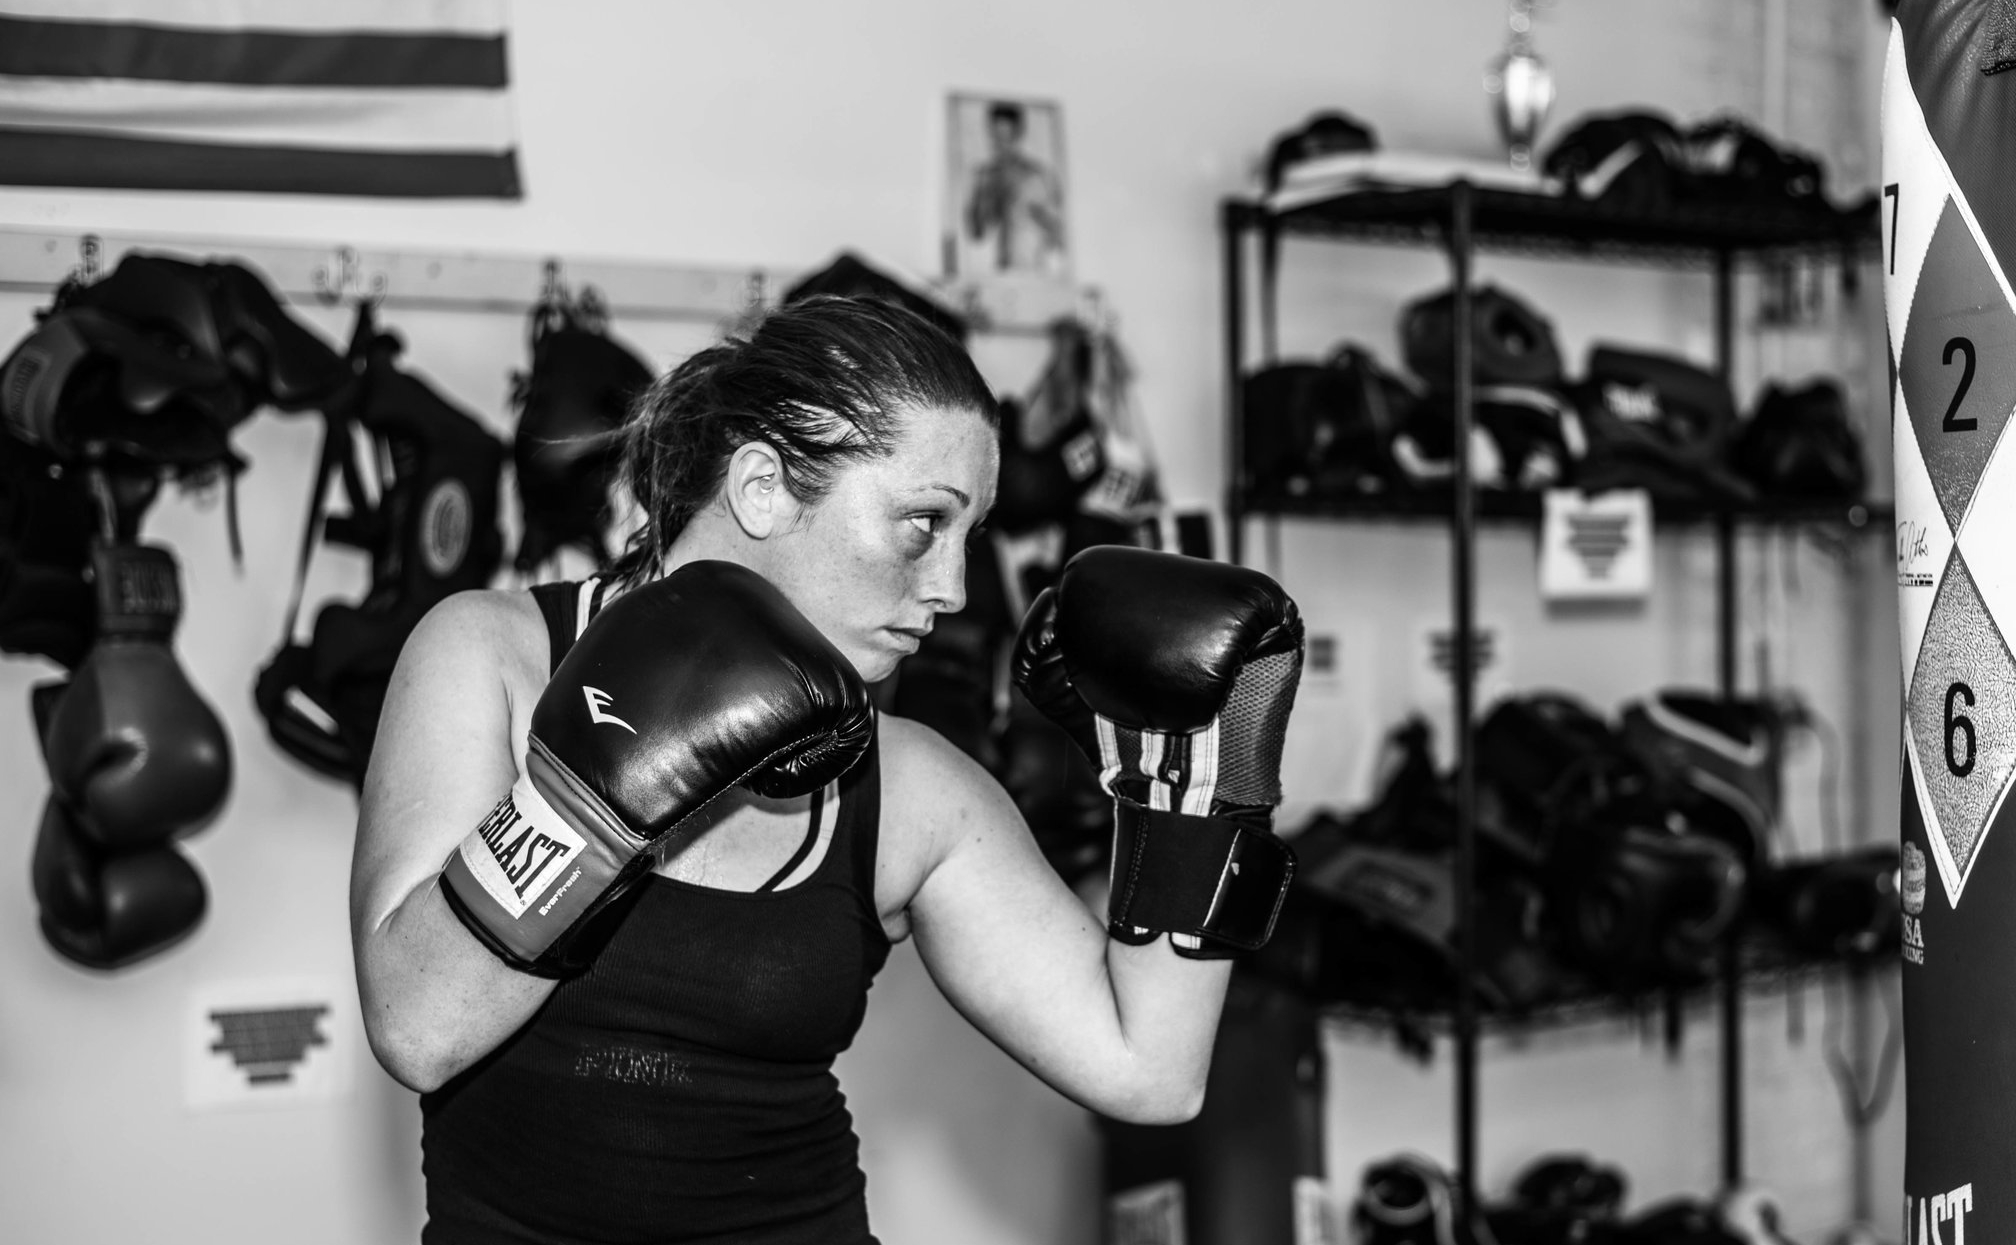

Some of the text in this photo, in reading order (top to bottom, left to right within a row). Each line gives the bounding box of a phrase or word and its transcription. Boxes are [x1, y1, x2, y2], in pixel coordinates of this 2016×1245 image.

[1884, 182, 1900, 276] 7
[1942, 336, 1978, 433] 2
[1943, 682, 1977, 778] 6
